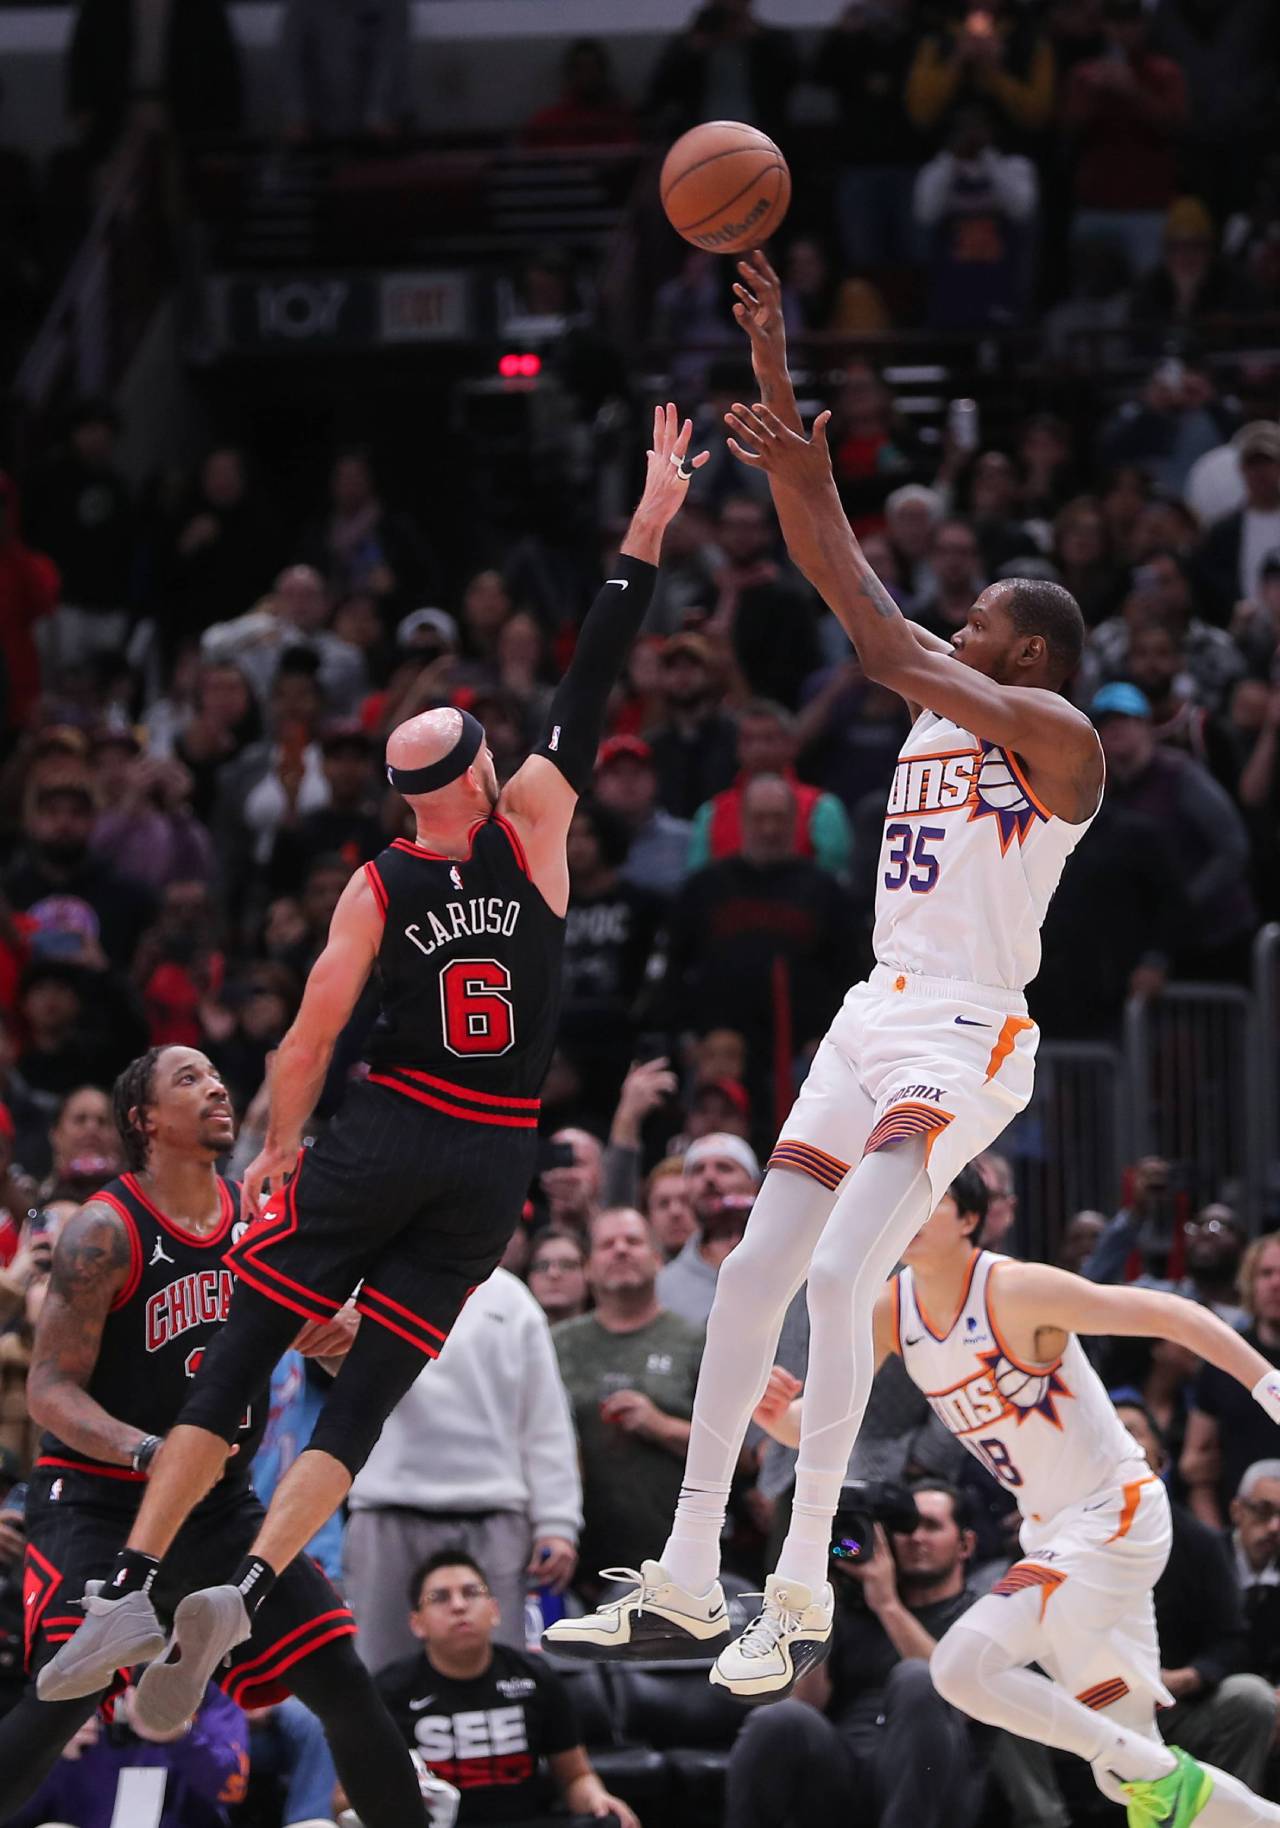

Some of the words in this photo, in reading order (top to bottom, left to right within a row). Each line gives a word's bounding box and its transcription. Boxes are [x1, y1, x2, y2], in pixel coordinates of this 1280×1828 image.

[887, 756, 974, 815] UNS
[884, 824, 946, 894] 35
[405, 898, 520, 955] CARUSO
[439, 958, 515, 1058] 6
[145, 1270, 238, 1353] CHICA
[414, 1705, 528, 1762] SEE
